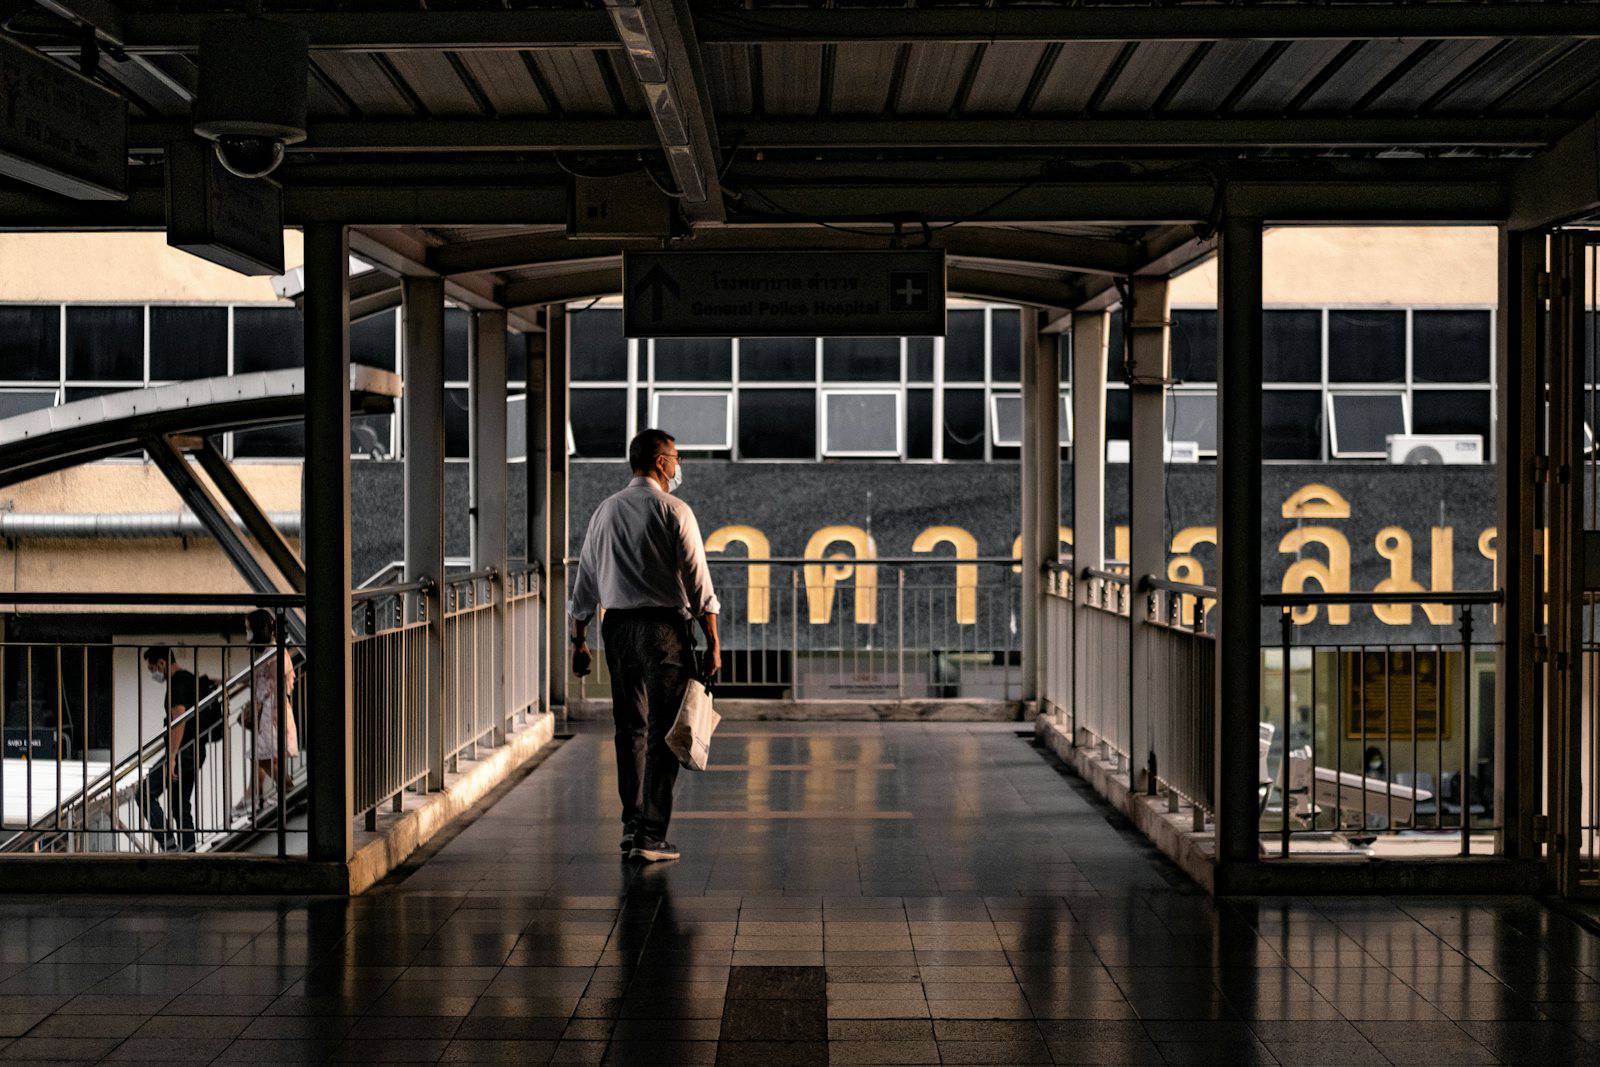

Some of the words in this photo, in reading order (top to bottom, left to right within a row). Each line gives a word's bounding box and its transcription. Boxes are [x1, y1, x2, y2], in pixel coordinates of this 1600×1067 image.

[691, 301, 753, 317] General
[758, 301, 808, 316] Police
[815, 300, 880, 317] Hospital
